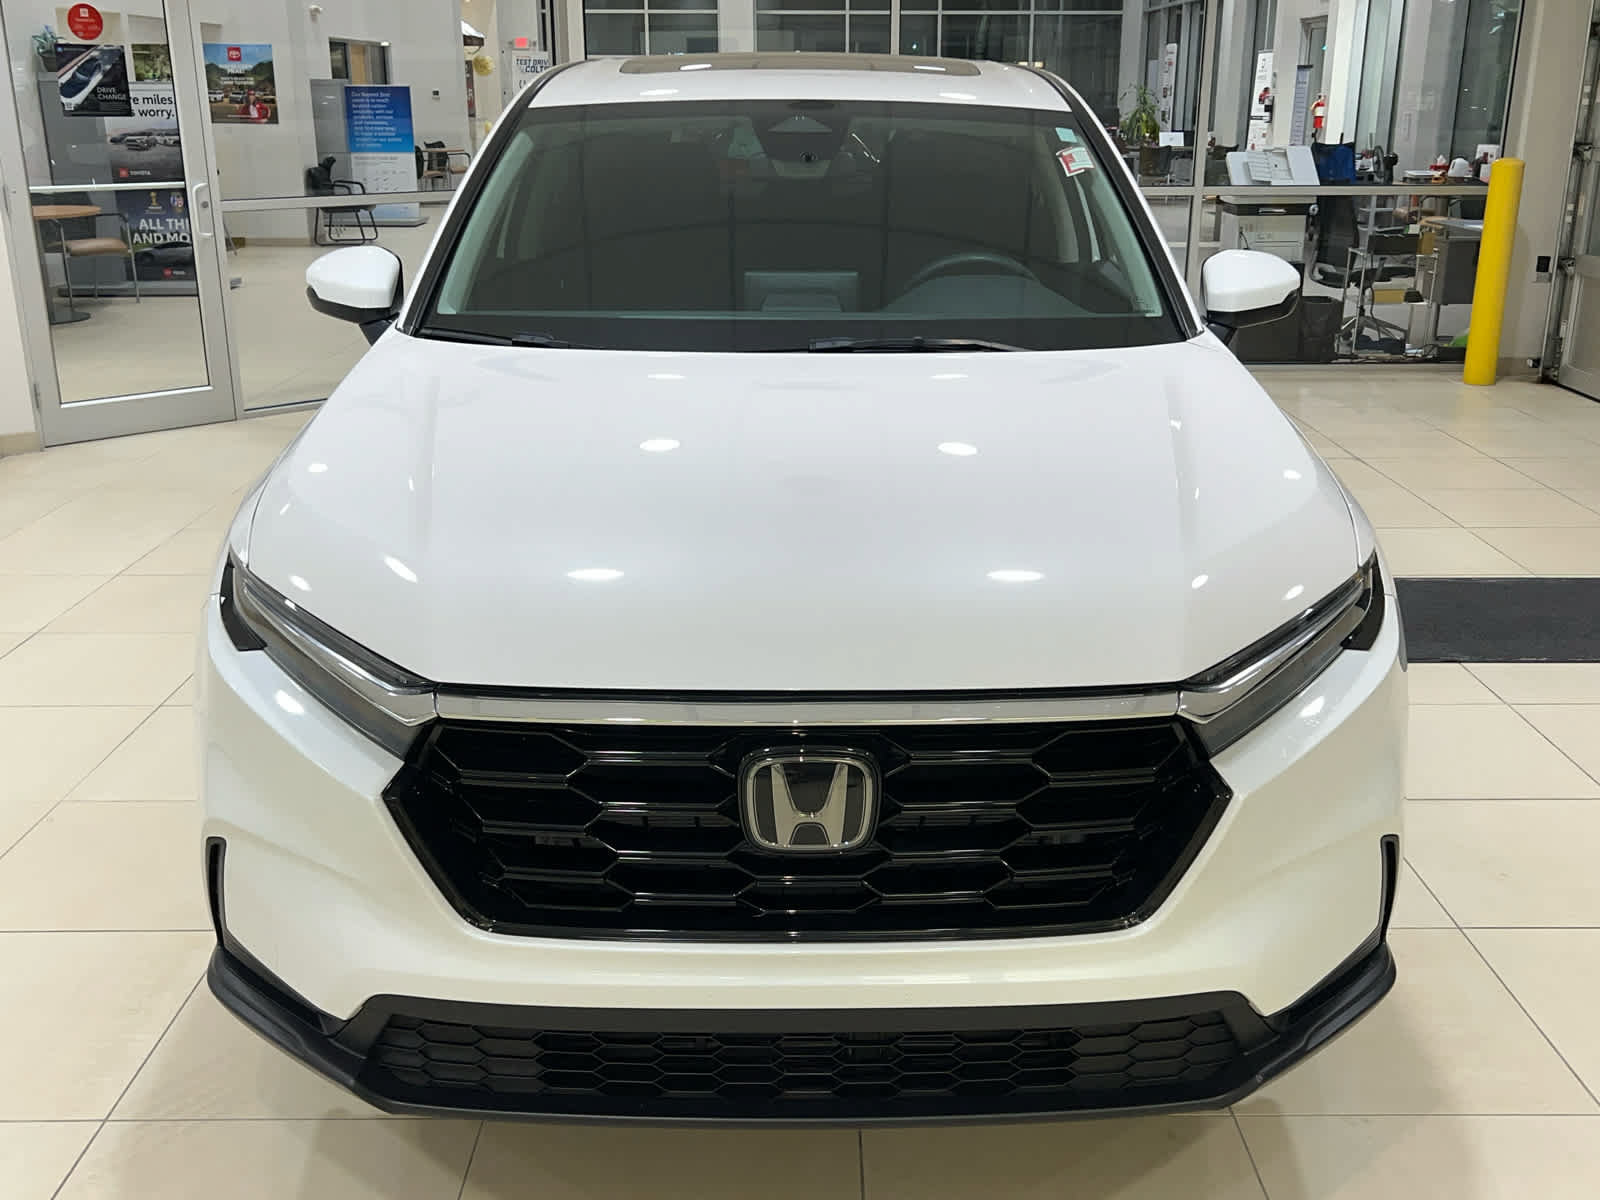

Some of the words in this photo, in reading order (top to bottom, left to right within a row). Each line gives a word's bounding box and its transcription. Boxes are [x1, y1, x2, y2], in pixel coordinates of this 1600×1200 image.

[138, 109, 175, 119] worry.
[139, 218, 164, 231] ALL
[133, 232, 164, 244] AND
